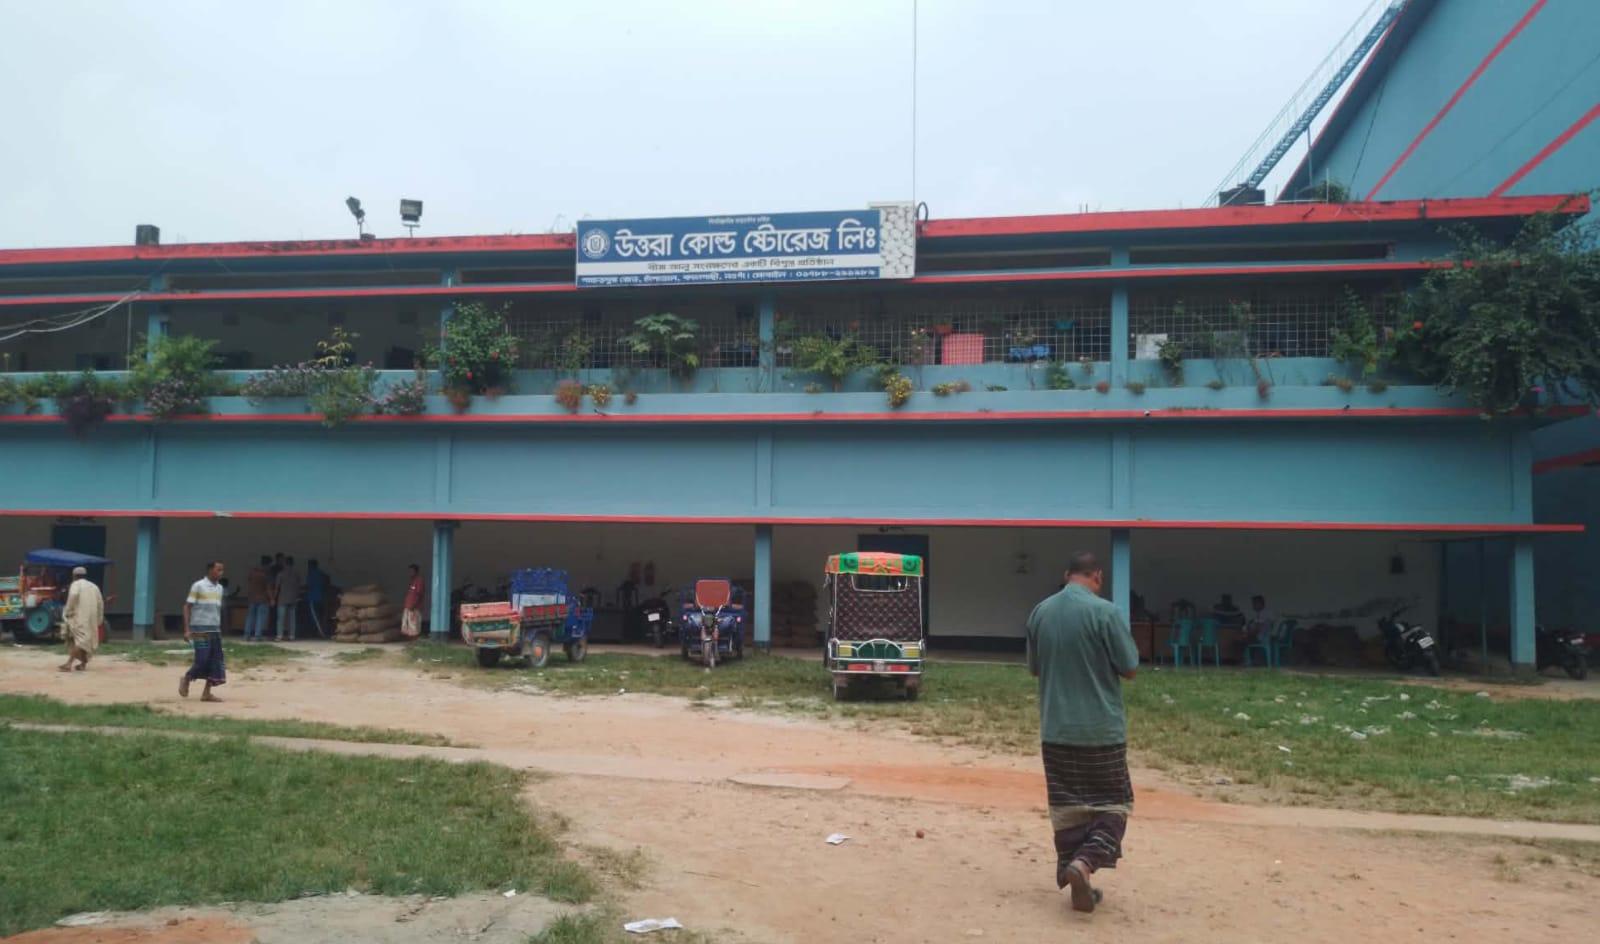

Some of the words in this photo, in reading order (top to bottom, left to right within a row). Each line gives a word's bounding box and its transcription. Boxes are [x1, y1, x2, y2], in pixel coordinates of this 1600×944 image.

[614, 228, 673, 257] উত্তরা
[680, 231, 737, 256] কোল্ড
[743, 223, 831, 253] ষ্টোরেজ
[836, 217, 877, 250] লিঃ
